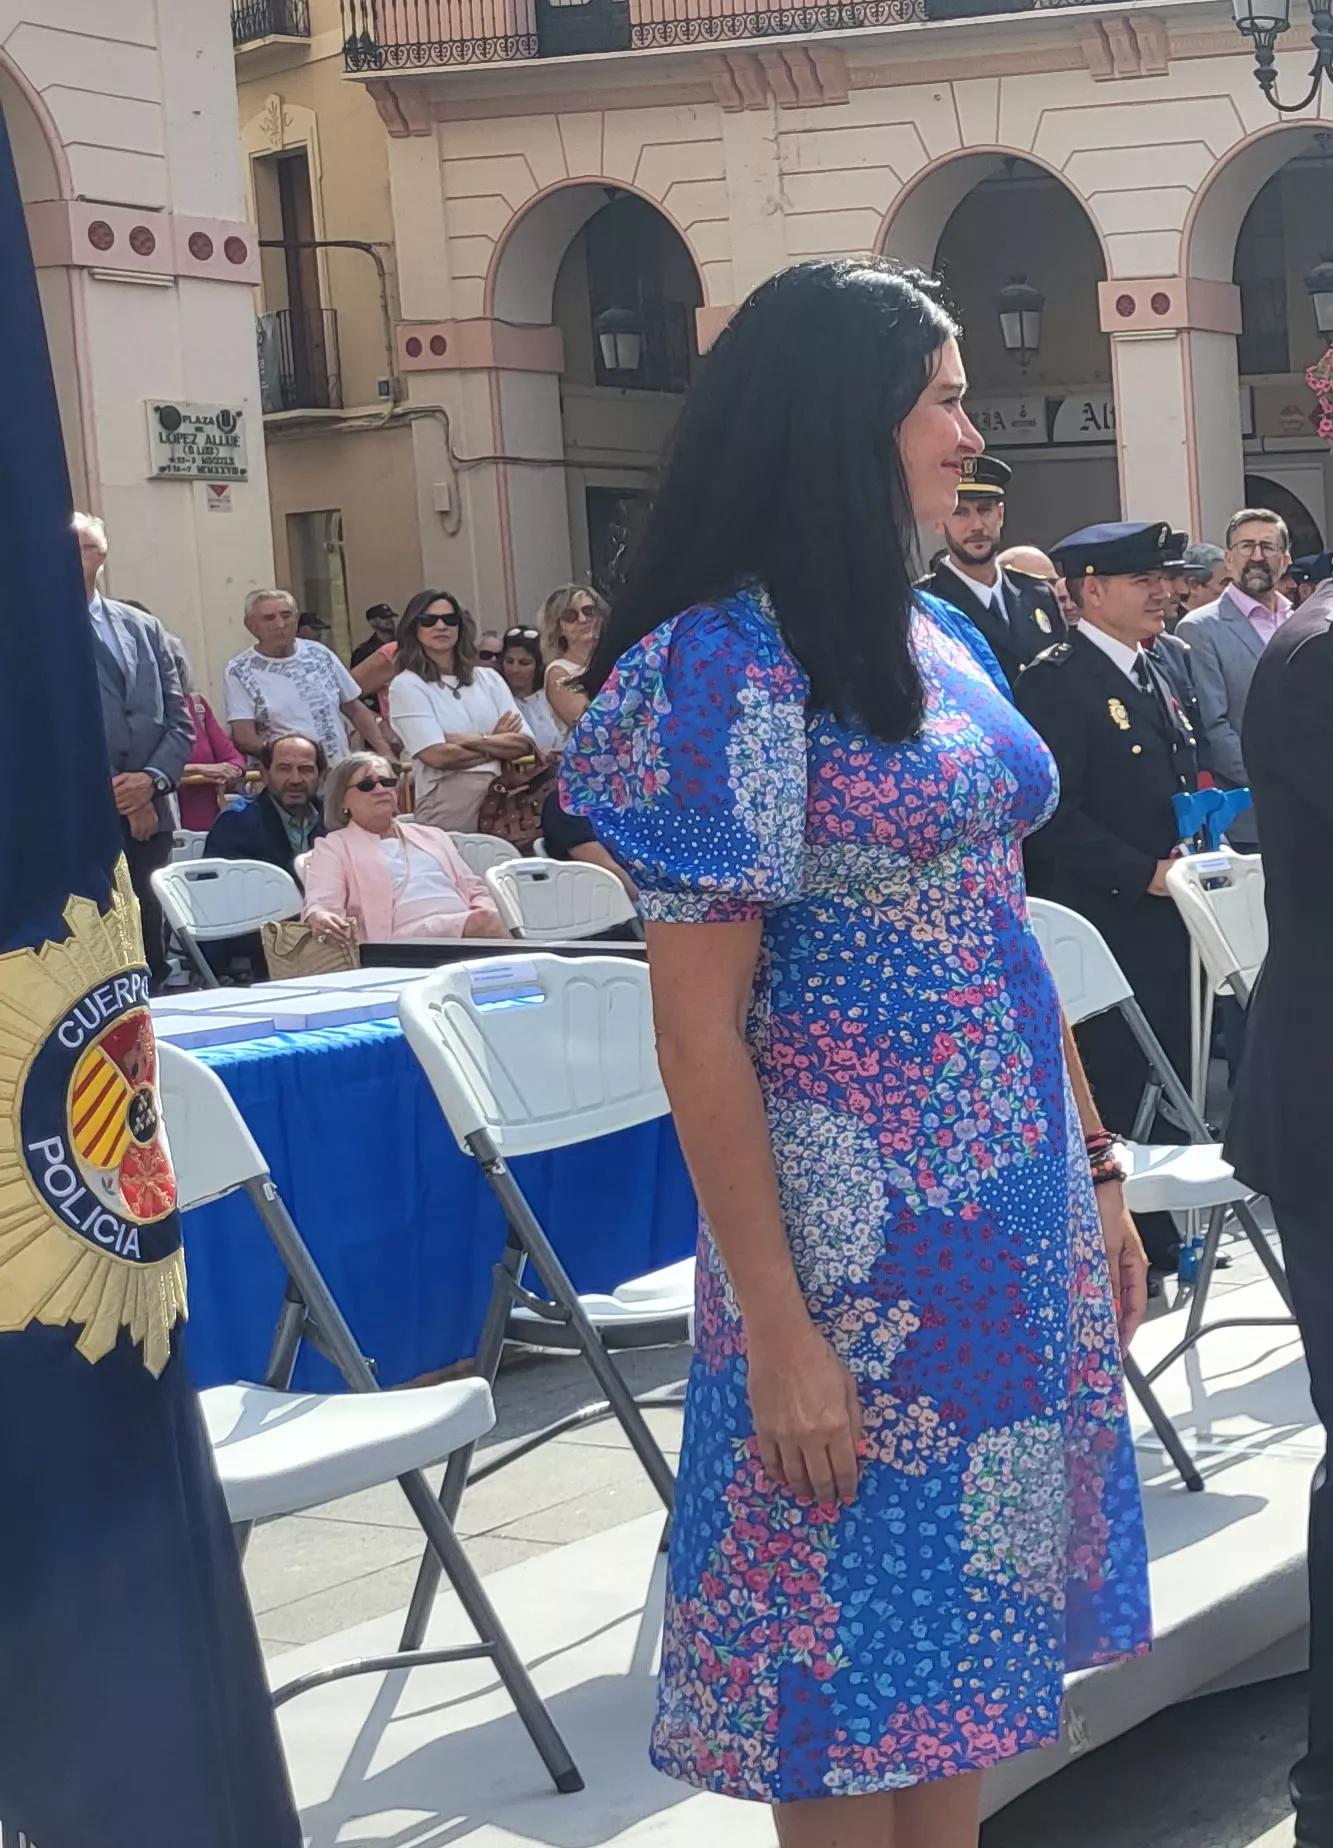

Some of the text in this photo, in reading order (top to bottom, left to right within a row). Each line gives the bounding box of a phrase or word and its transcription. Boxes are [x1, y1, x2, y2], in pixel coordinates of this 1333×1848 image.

[182, 415, 216, 426] PLAZA
[58, 973, 149, 1048] CUERPO
[28, 1135, 141, 1259] POLICIA
